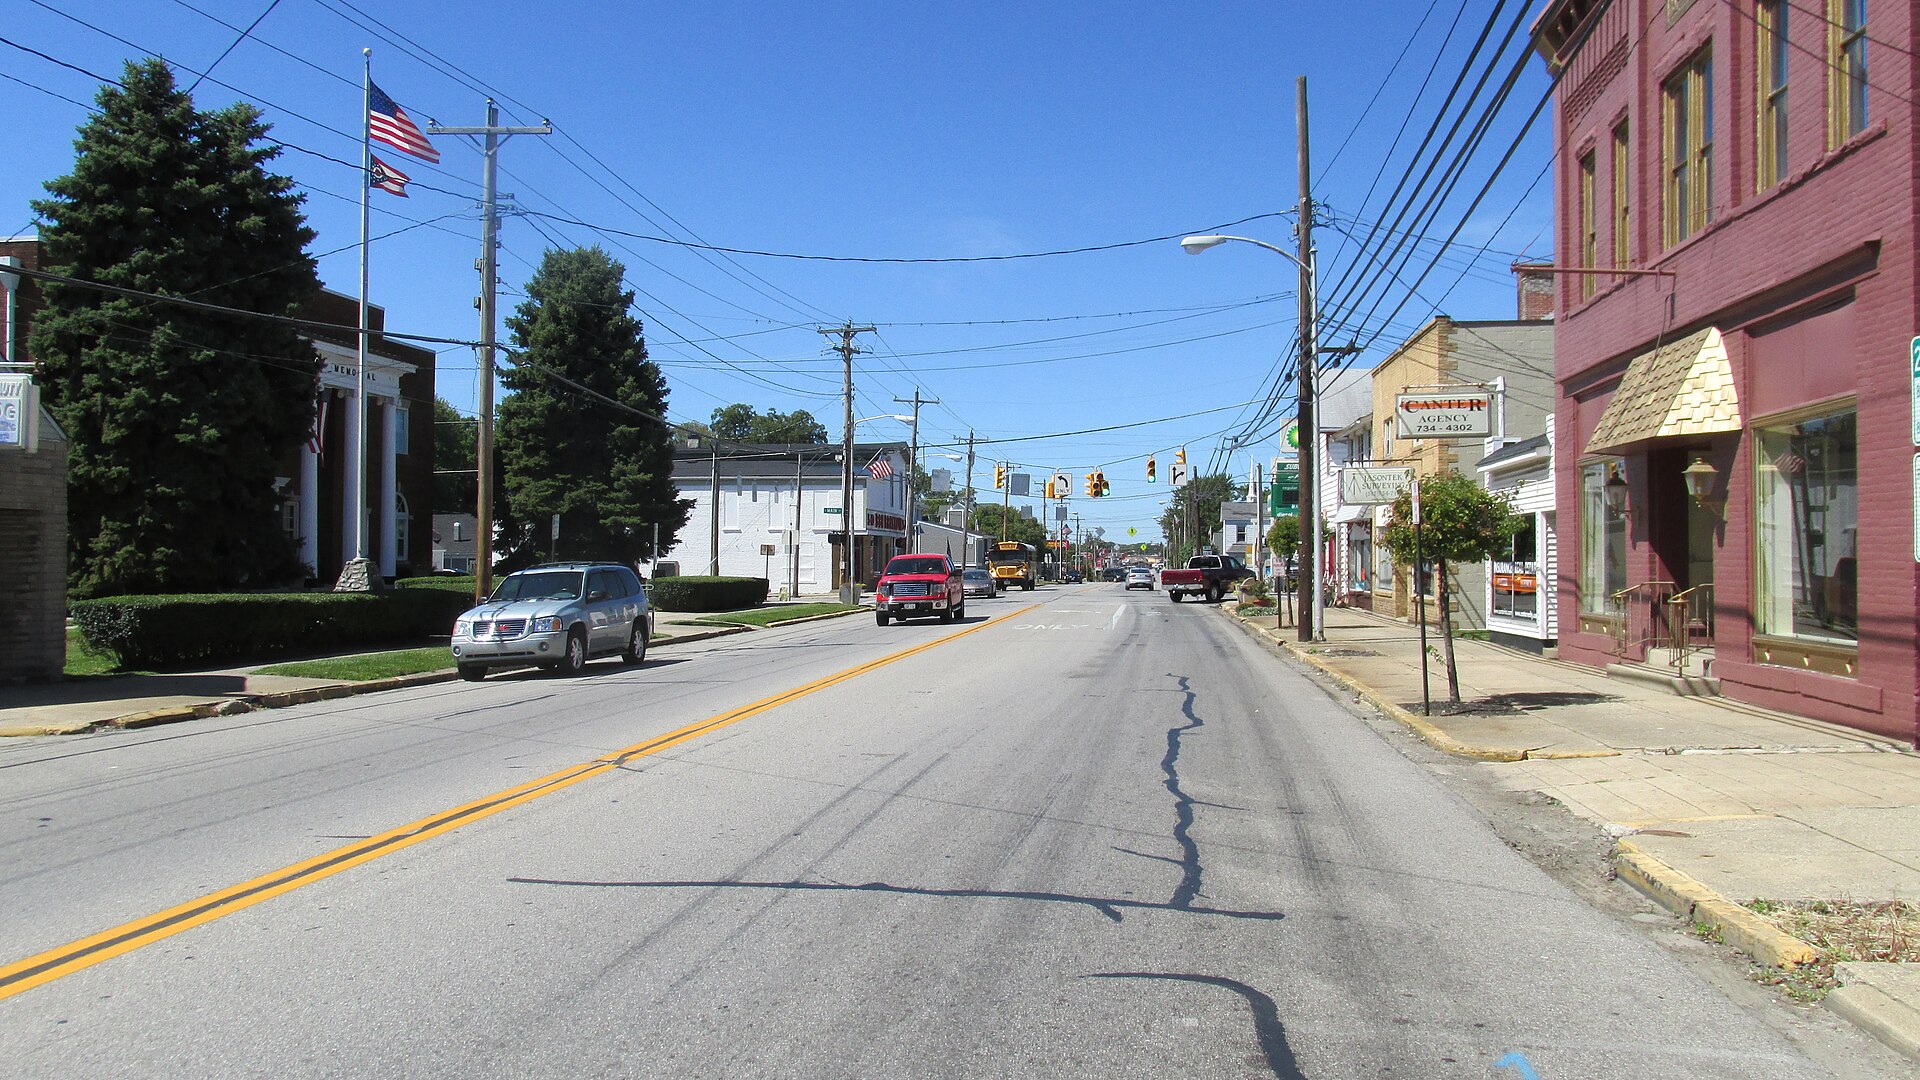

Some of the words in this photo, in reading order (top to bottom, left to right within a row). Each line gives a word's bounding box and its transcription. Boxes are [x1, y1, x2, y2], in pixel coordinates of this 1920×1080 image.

[334, 364, 376, 381] MEMOAL
[0, 382, 22, 397] UTY
[1405, 399, 1483, 413] CANTER
[1419, 414, 1470, 423] AGENCY
[1362, 482, 1405, 490] SURVEYING
